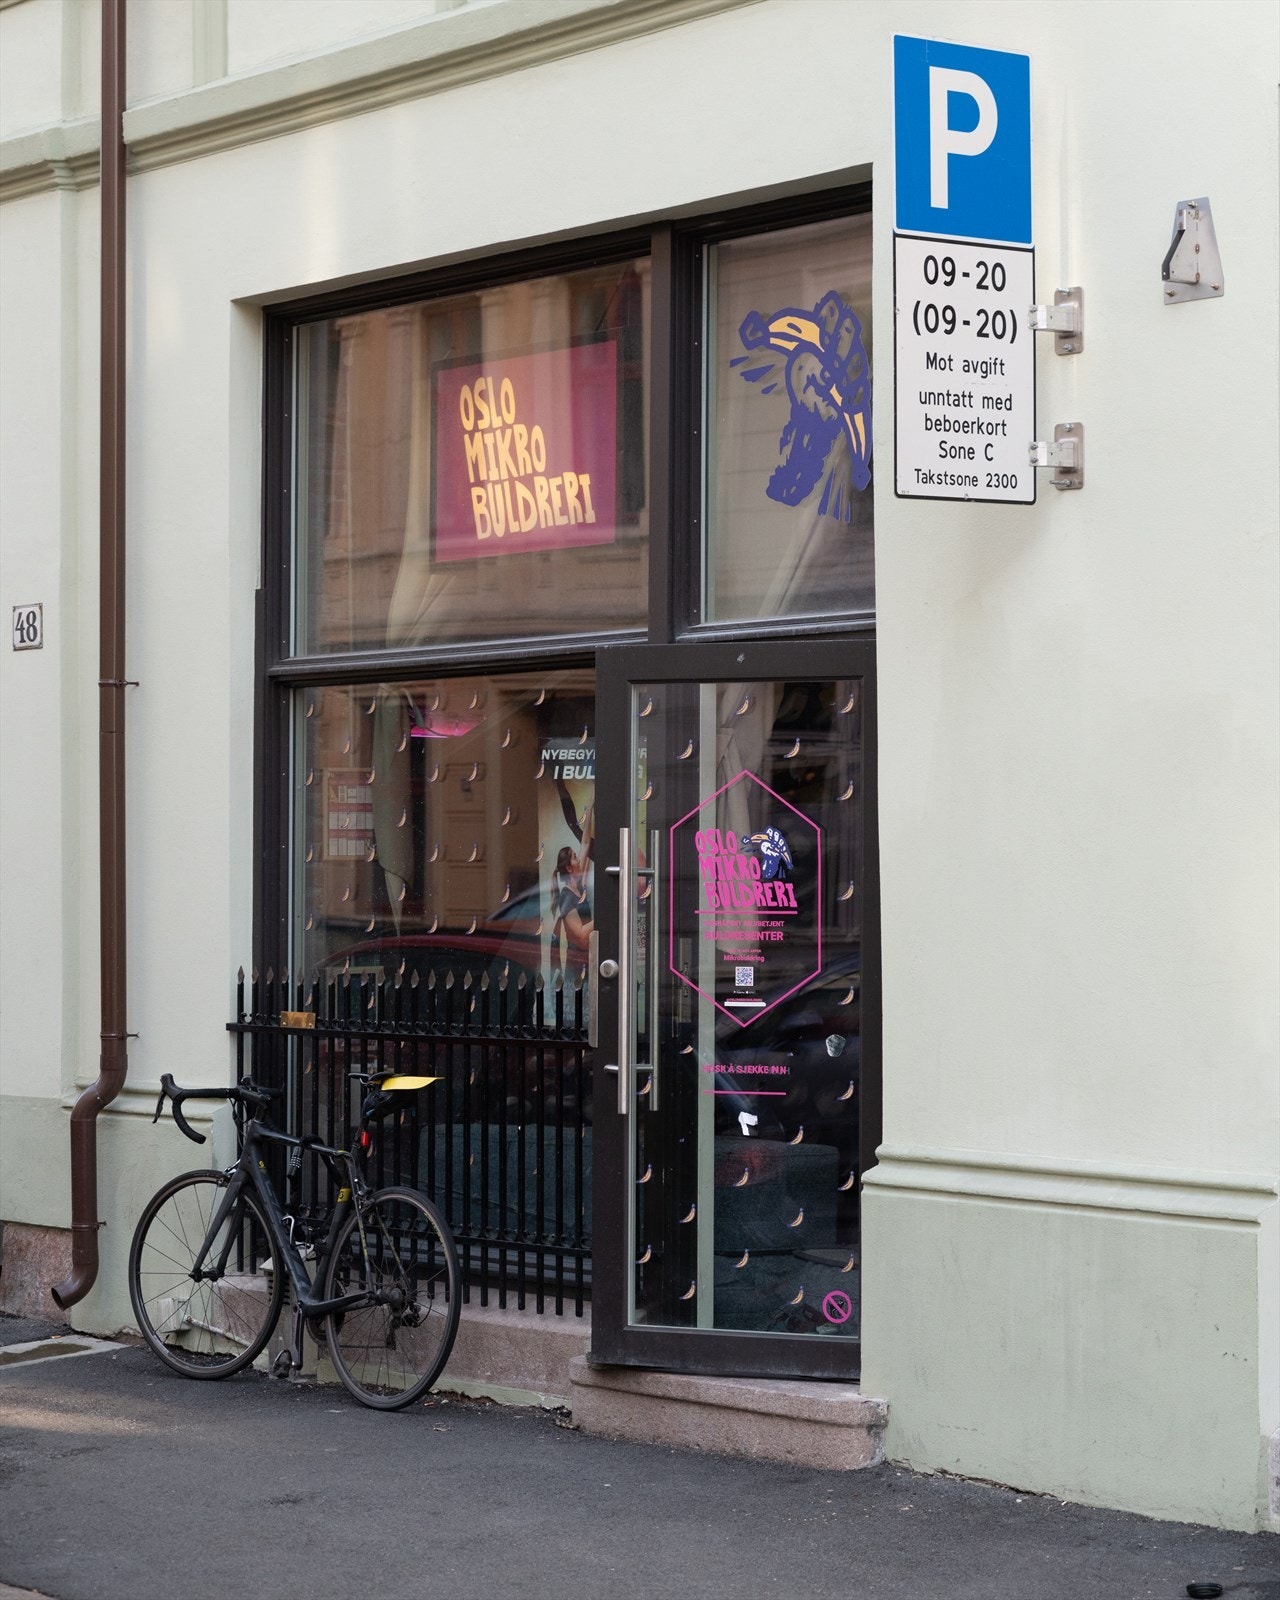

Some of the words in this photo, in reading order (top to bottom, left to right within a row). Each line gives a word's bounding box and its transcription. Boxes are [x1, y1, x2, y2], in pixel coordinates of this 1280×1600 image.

[929, 66, 998, 209] P
[923, 255, 1007, 292] 09-20
[912, 300, 1018, 345] (09-20)
[926, 351, 953, 372] Mot
[962, 357, 1005, 379] avgift
[459, 376, 516, 432] OSLO
[919, 389, 974, 409] unntatt
[982, 393, 1013, 412] med
[925, 413, 1007, 437] beboerkort
[463, 423, 546, 483] MIKRO
[938, 440, 975, 461] Sone
[984, 443, 994, 462] C
[914, 468, 979, 488] Takstsone
[985, 473, 1018, 489] 2300
[470, 471, 596, 541] BULDRERI
[15, 610, 38, 643] 48
[541, 748, 596, 760] NYBEGY
[562, 765, 596, 780] BUL
[694, 828, 738, 855] OSLO
[698, 854, 761, 881] MIKRO
[704, 880, 798, 908] BULDRERI
